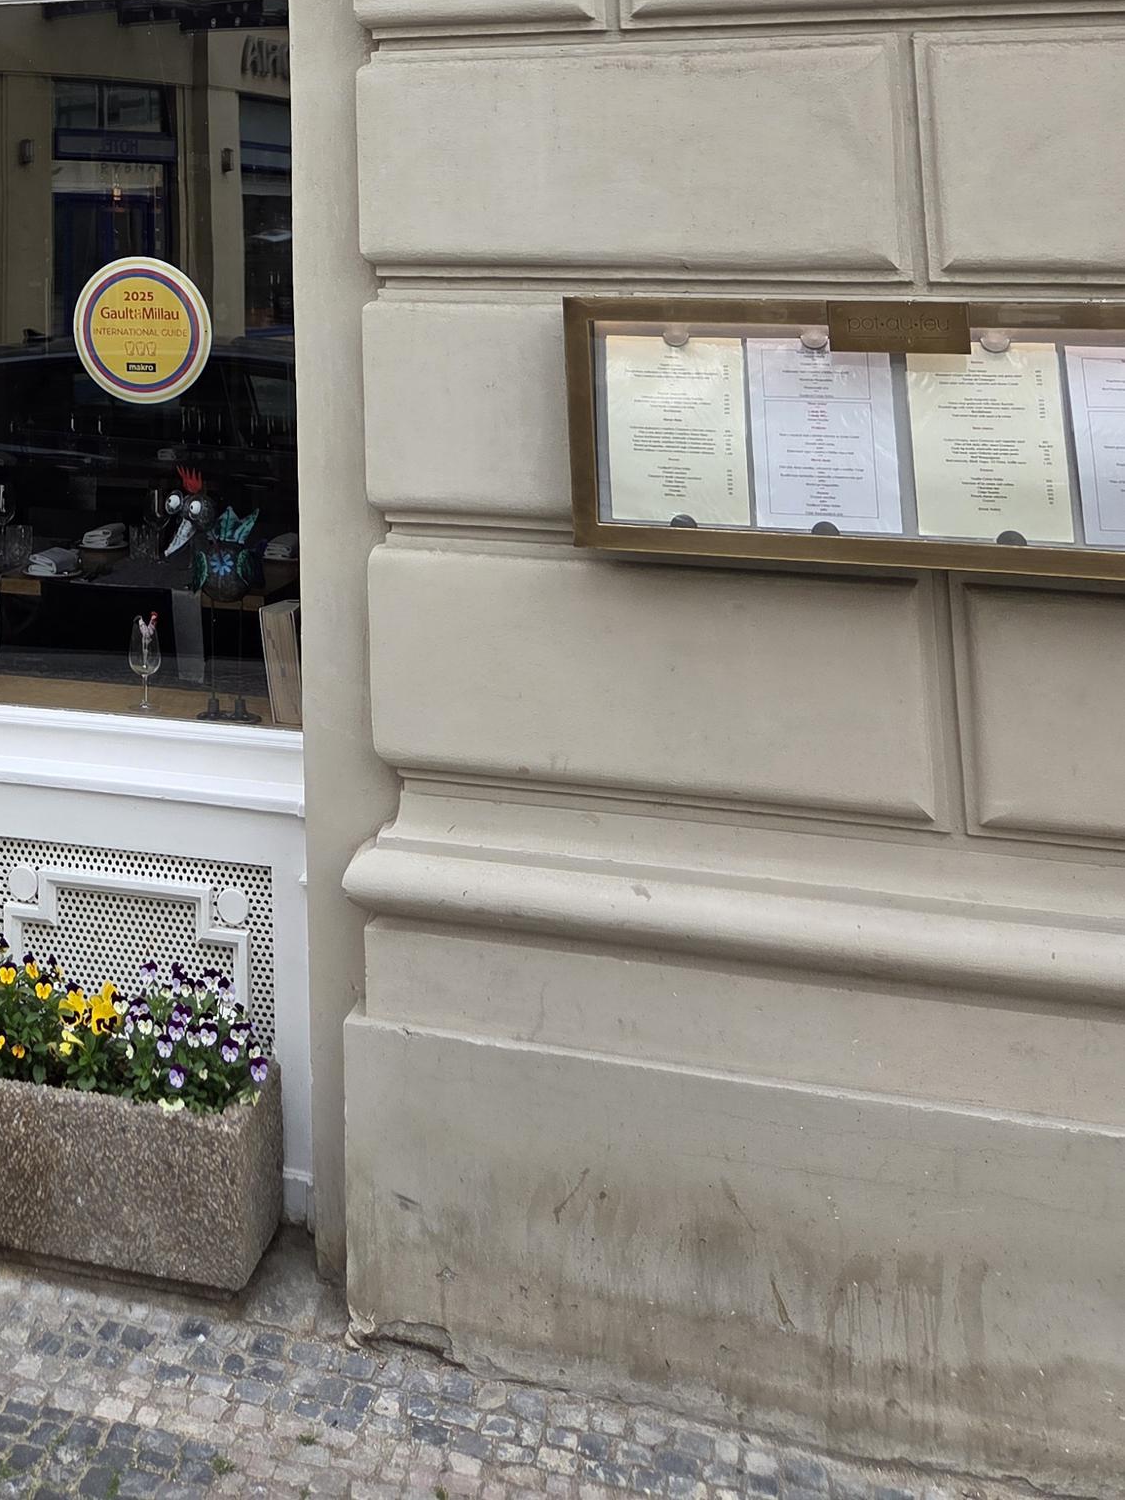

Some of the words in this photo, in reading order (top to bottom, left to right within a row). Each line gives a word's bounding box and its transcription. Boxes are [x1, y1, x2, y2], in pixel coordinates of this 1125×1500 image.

[123, 291, 154, 302] 2025
[93, 327, 158, 338] INTERNATIONAL
[161, 328, 188, 338] GUIDE
[128, 363, 154, 371] makro
